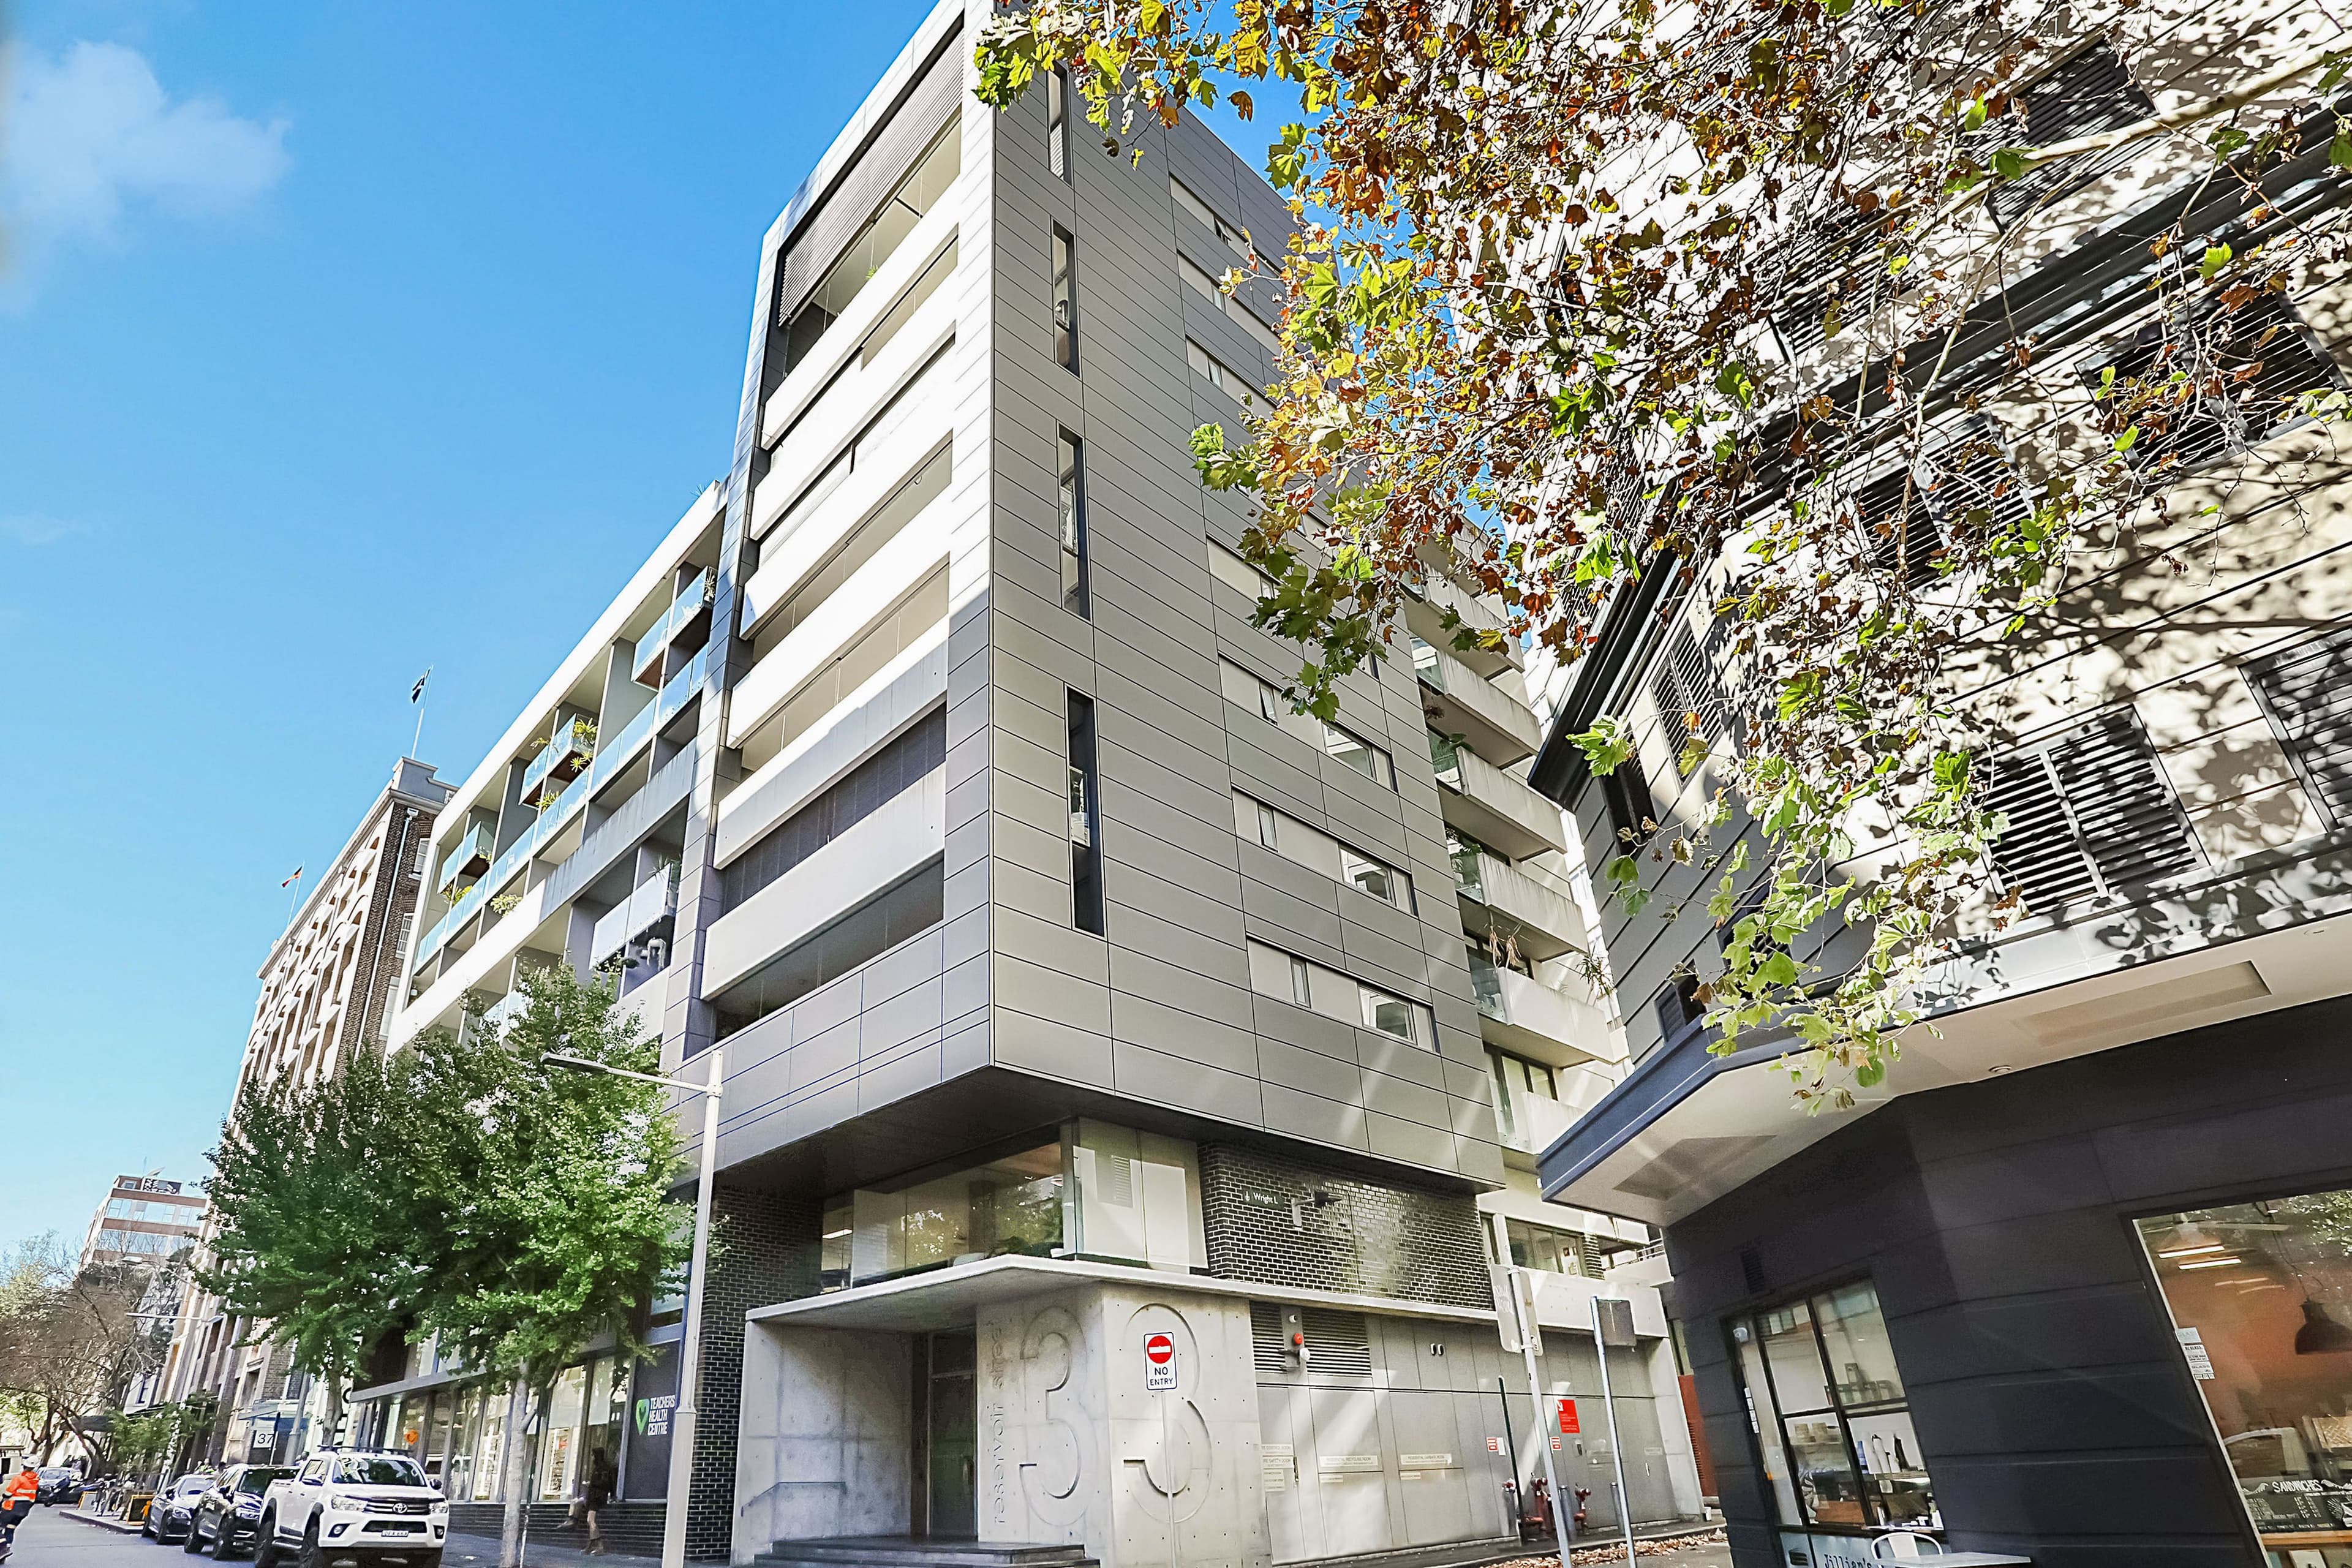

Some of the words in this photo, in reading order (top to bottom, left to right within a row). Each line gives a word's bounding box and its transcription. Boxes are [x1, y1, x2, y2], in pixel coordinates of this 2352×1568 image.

[1253, 1192, 1273, 1204] Wright
[1155, 1366, 1168, 1376] NO
[650, 1395, 676, 1409] TEACHERS
[649, 1408, 668, 1422] HEALTH
[647, 1421, 668, 1436] CENTRE
[257, 1433, 274, 1444] 37
[2272, 1479, 2323, 1493] SANDWICHES
